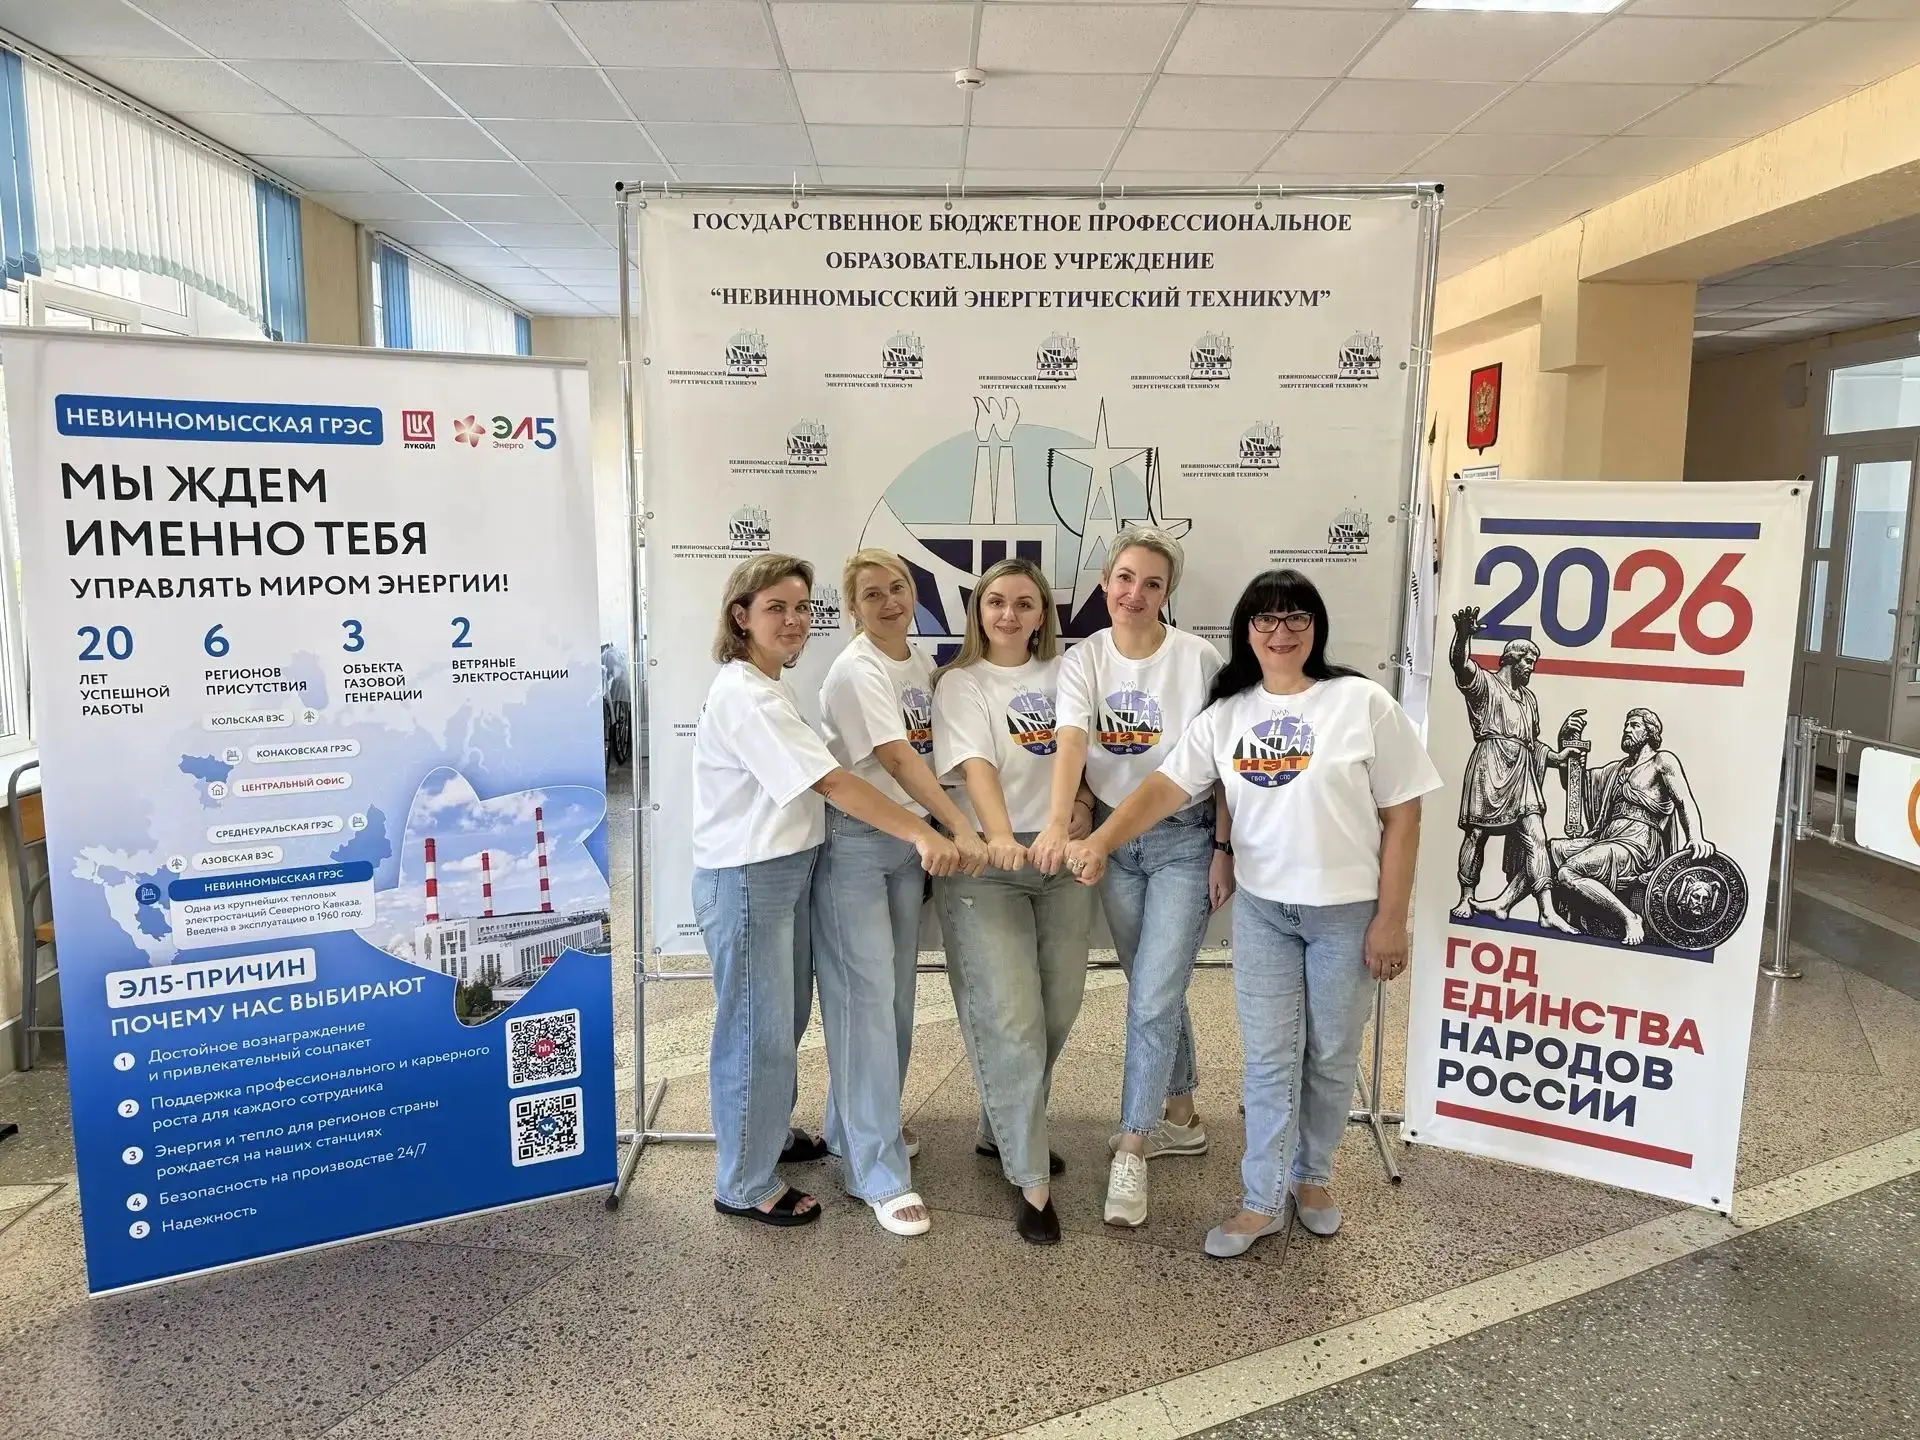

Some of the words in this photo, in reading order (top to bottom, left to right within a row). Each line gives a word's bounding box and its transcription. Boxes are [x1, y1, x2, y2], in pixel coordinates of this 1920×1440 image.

[692, 213, 923, 234] ГОСУДАРСТВЕННОЕ
[929, 213, 1081, 234] БЮДЖЕТНОЕ
[1088, 213, 1352, 232] ПРОФЕССИОНАЛЬНОЕ
[826, 251, 1047, 271] ОБРАЗОВАТЕЛЬНОЕ
[1054, 251, 1215, 273] УЧРЕЖДЕНИЕ
[964, 287, 1180, 308] ЭНЕРГЕТИЧЕСКИЙ
[66, 407, 313, 434] НЕВИННОМЫССКАЯ
[319, 417, 373, 435] ГРЭС
[404, 442, 436, 450] ЛУКОЙЛ
[493, 441, 524, 450] Энерго
[61, 462, 153, 501] МЫ
[166, 466, 327, 508] ЖДЕМ
[65, 520, 305, 556] ИМЕННО
[314, 521, 427, 555] ТЕБЯ
[70, 577, 252, 599] УПРАВЛЯТЬ
[260, 575, 370, 597] МИРОМ
[378, 573, 509, 594] ЭНЕРГИИ!
[1474, 545, 1753, 656] 2026
[77, 625, 133, 661] 20
[203, 623, 230, 658] 6
[342, 619, 365, 652] 3
[451, 616, 472, 649] 2
[205, 667, 281, 681] РЕГИОНОВ
[343, 662, 403, 674] ОБЪЕКТА
[452, 658, 516, 670] ВЕТРЯНЫЕ
[452, 669, 569, 683] ЭЛЕКТРОСТАНЦИИ
[79, 673, 108, 685] ЛЕТ
[206, 681, 307, 696] ПРИСУТСТВИЯ
[344, 674, 406, 689] ГАЗОВОЙ
[80, 685, 170, 701] УСПЕШНОЙ
[345, 690, 423, 703] ГЕНЕРАЦИИ
[82, 703, 144, 716] РАБОТЫ
[211, 715, 264, 726] КОЛЬСКАЯ
[266, 714, 285, 723] ВЭС
[1019, 730, 1053, 743] НЭ
[1101, 732, 1153, 743] НЭТ
[256, 745, 328, 758] КОНАКОВСКАЯ
[330, 744, 353, 753] ГРЭС
[1240, 757, 1302, 771] НЭТ
[241, 777, 314, 793] ЦЕНТРАЛЬНЫЙ
[315, 776, 345, 787] ОФИС
[216, 822, 309, 839] СРЕДНЕУРАЛЬСКАЯ
[311, 820, 333, 829] ГРЭС
[201, 853, 254, 866] АЗОВСКАЯ
[255, 851, 274, 860] ВЭС
[204, 872, 316, 893] НЕВИННОМЫССКАЯ
[317, 869, 344, 880] ГРЭС
[184, 904, 211, 914] Одна
[213, 902, 225, 911] из
[227, 896, 289, 911] крупнейших
[291, 891, 337, 903] тепловых
[185, 909, 267, 926] электростанций
[268, 903, 321, 917] Северного
[322, 899, 362, 909] Кавказа.
[186, 925, 228, 936] Введена
[238, 915, 307, 932] эксплуатацию
[317, 911, 339, 921] 1960
[341, 909, 364, 920] году.
[1445, 936, 1538, 988] ГОД
[118, 957, 306, 999] ЭЛ5-ПРИЧИН
[111, 1004, 225, 1037] ПОЧЕМУ
[232, 996, 284, 1020] НАС
[289, 976, 426, 1009] ВЫБИРАЮТ
[1443, 977, 1704, 1055] ЕДИНСТВА
[148, 1041, 238, 1064] Достойное
[242, 1021, 366, 1049] вознаграждение
[1439, 1018, 1673, 1090] НАРОДОВ
[149, 1071, 158, 1081] и
[163, 1047, 301, 1080] привлекательный
[304, 1038, 372, 1057] соцпакет
[151, 1087, 241, 1109] Поддержка
[246, 1061, 395, 1095] профессионального
[400, 1059, 408, 1069] и
[411, 1046, 490, 1067] карьерного
[1437, 1058, 1637, 1127] РОССИИ
[152, 1114, 198, 1132] роста
[201, 1109, 229, 1123] для
[233, 1097, 296, 1116] каждого
[300, 1082, 383, 1104] сотрудника
[155, 1138, 221, 1158] Энергия
[226, 1136, 235, 1145] и
[239, 1127, 284, 1143] тепло
[287, 1121, 314, 1135] для
[318, 1109, 386, 1131] регионов
[389, 1099, 439, 1115] страны
[157, 1154, 239, 1180] рождается
[243, 1150, 261, 1161] на
[265, 1140, 312, 1157] наших
[316, 1128, 382, 1147] станциях
[159, 1177, 267, 1205] Безопасность
[271, 1171, 288, 1183] на
[292, 1152, 394, 1180] производстве
[397, 1142, 427, 1159] 24/7
[162, 1206, 257, 1233] Надежность
